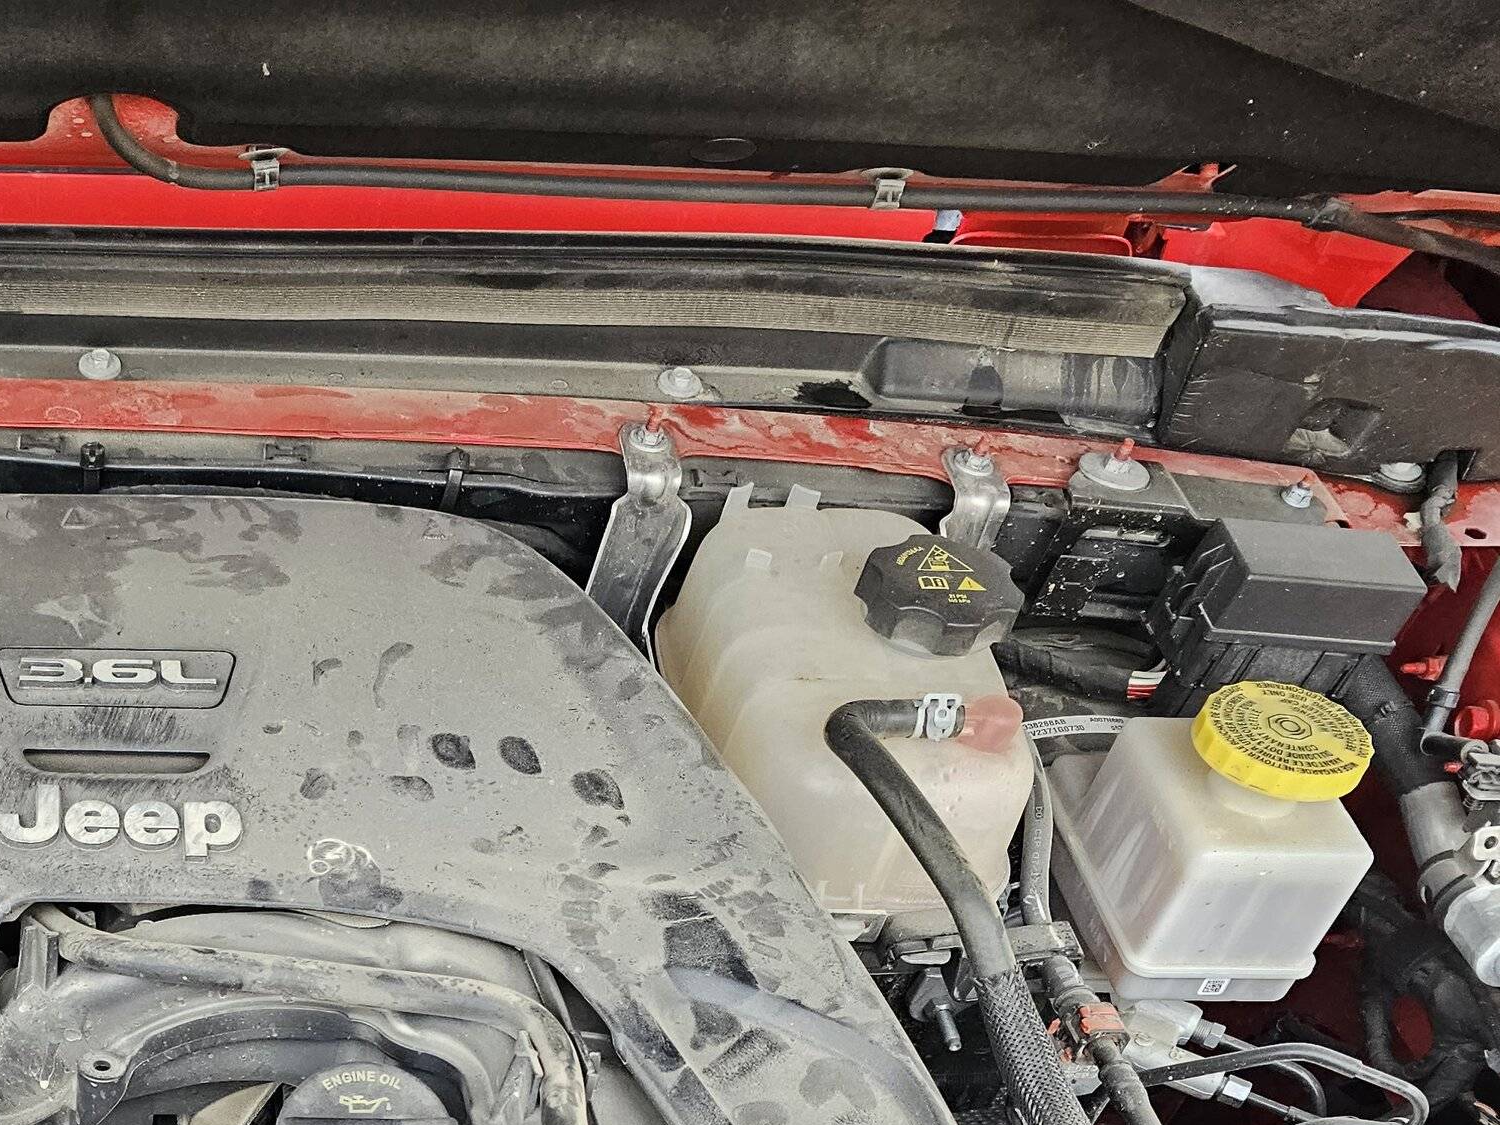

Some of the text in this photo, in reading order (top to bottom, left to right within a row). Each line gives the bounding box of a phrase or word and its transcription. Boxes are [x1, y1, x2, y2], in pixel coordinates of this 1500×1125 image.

[18, 658, 218, 690] 3.6L
[1262, 689, 1286, 697] ONLY
[1288, 693, 1307, 702] USE
[1250, 745, 1290, 764] RETIRER
[1264, 744, 1284, 756] DOT
[1247, 752, 1294, 772] NETTOYER
[322, 1070, 402, 1091] ENGINE OIL
